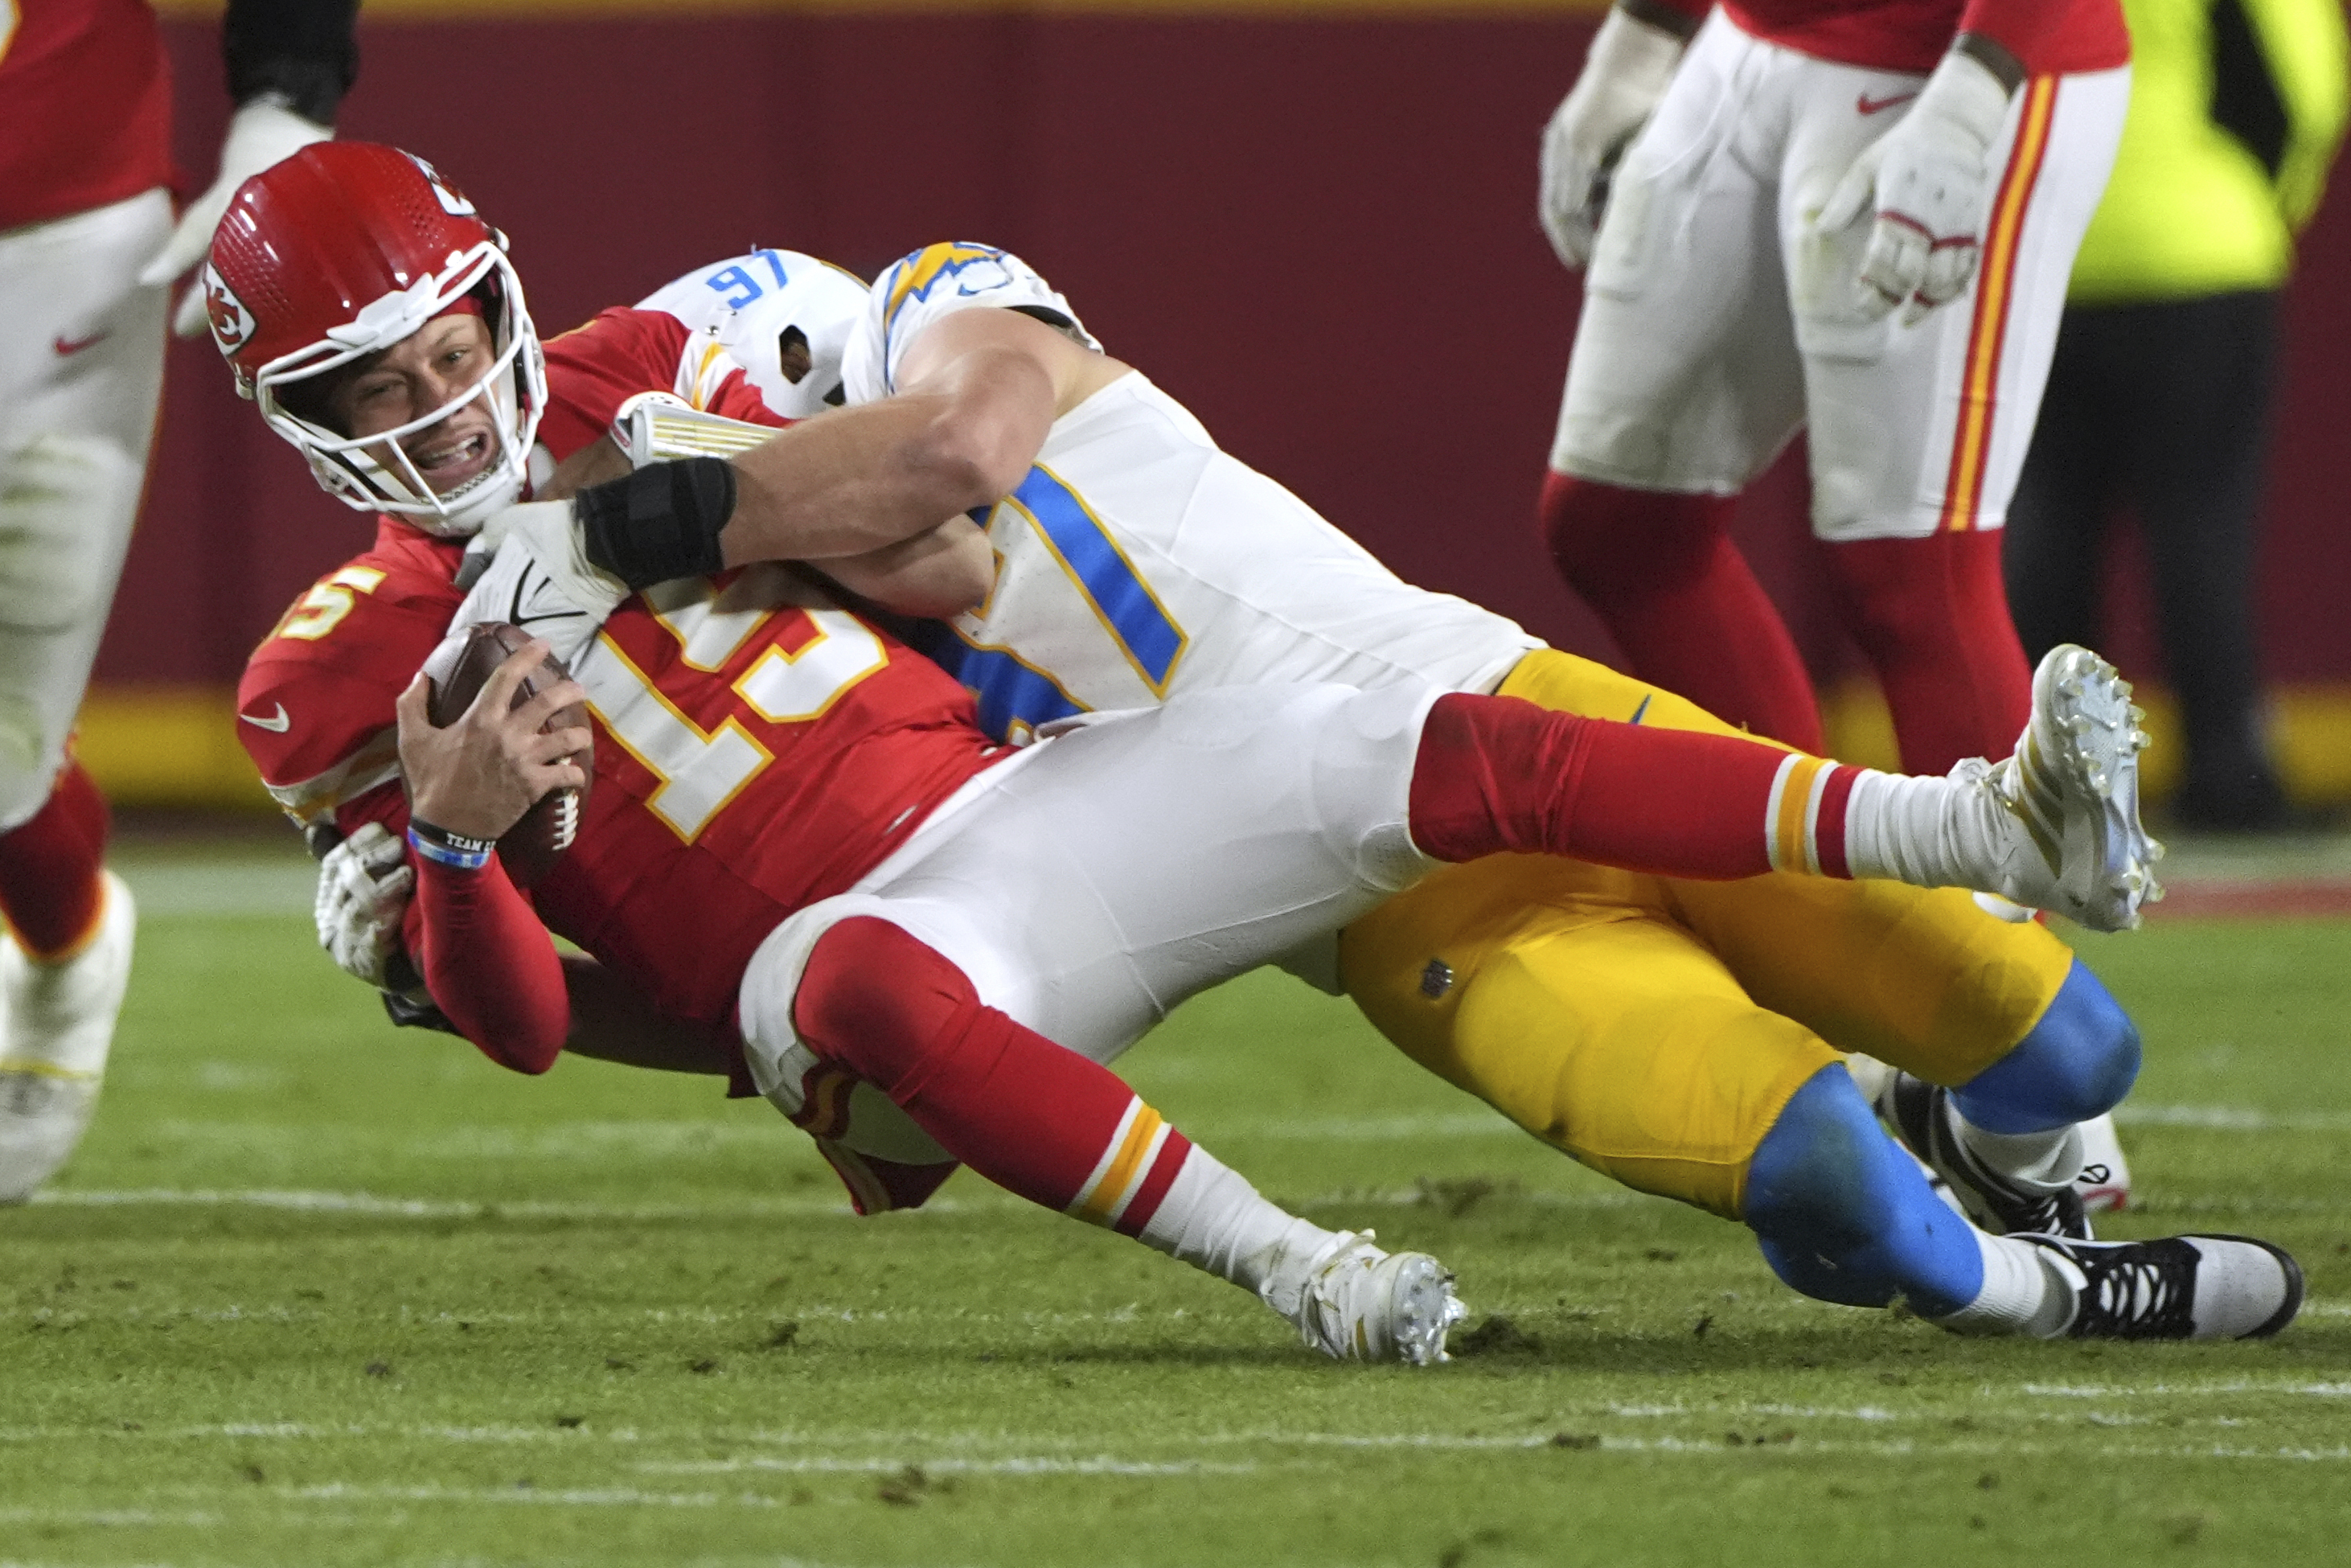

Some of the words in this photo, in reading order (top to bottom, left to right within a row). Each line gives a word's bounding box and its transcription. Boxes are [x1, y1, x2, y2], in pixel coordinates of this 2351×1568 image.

[707, 250, 788, 310] 97
[572, 577, 889, 847] 15
[446, 832, 482, 852] TEAM
